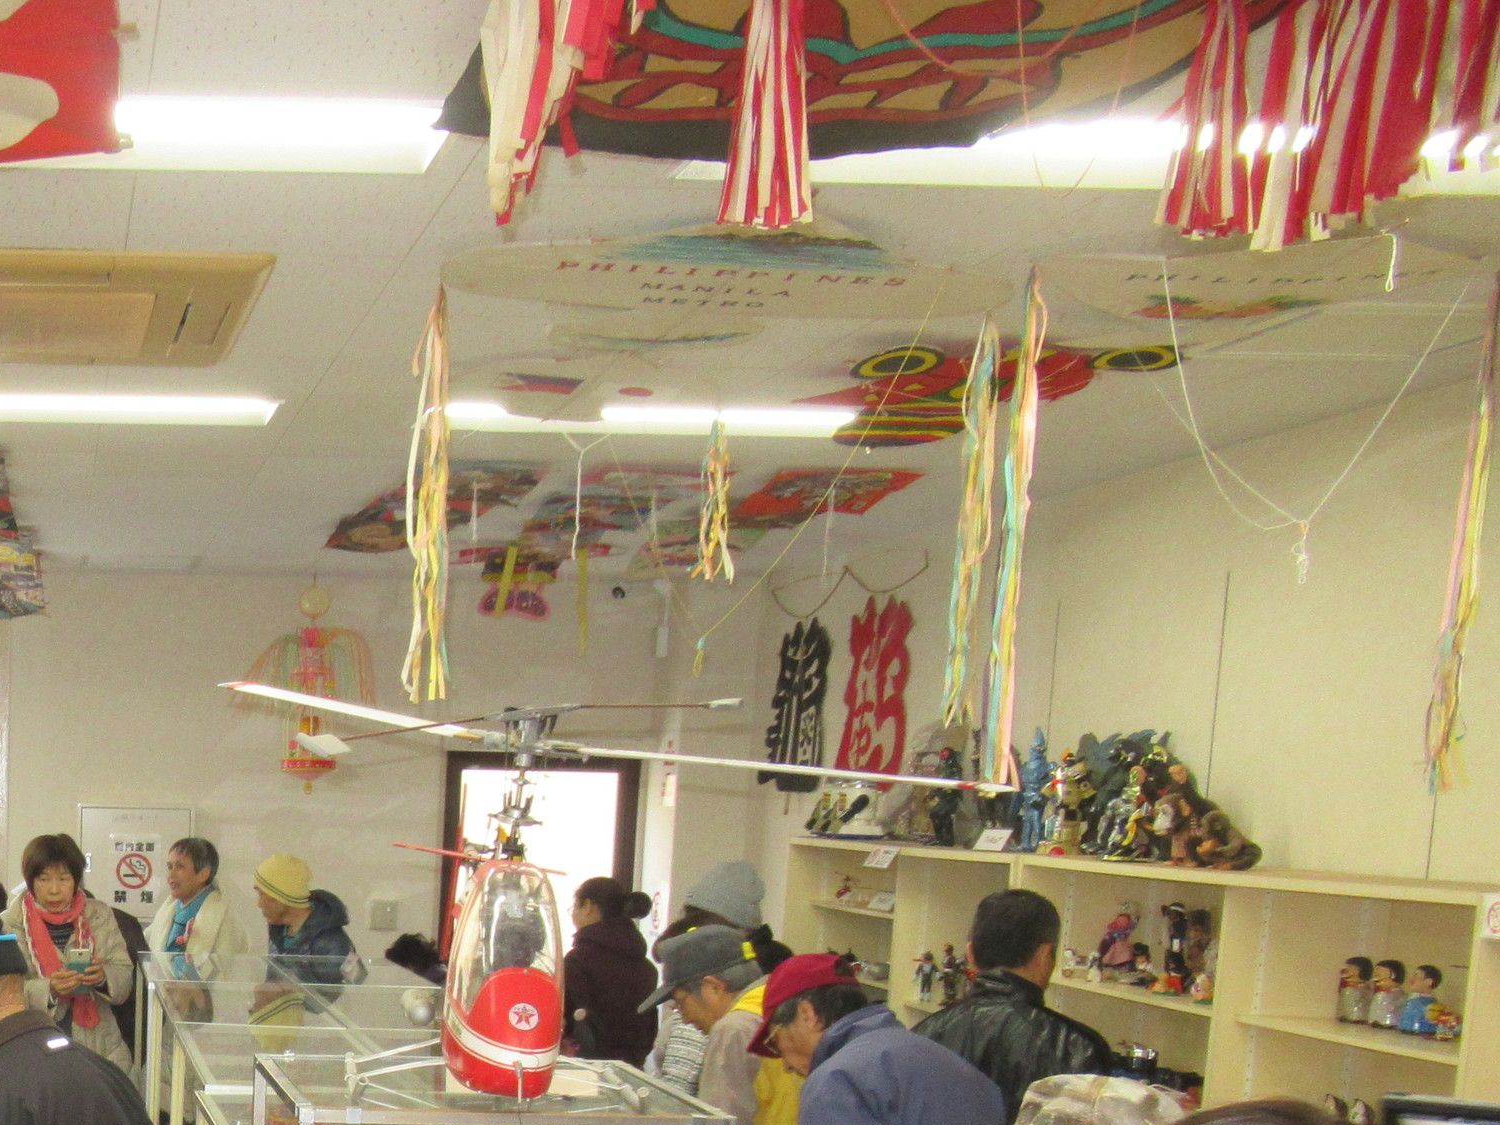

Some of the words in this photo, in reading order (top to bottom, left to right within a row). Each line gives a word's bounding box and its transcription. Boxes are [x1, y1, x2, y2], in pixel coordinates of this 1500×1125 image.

[556, 260, 906, 287] PHILIPPINES
[640, 281, 791, 297] MANILA
[642, 296, 765, 308] METRO
